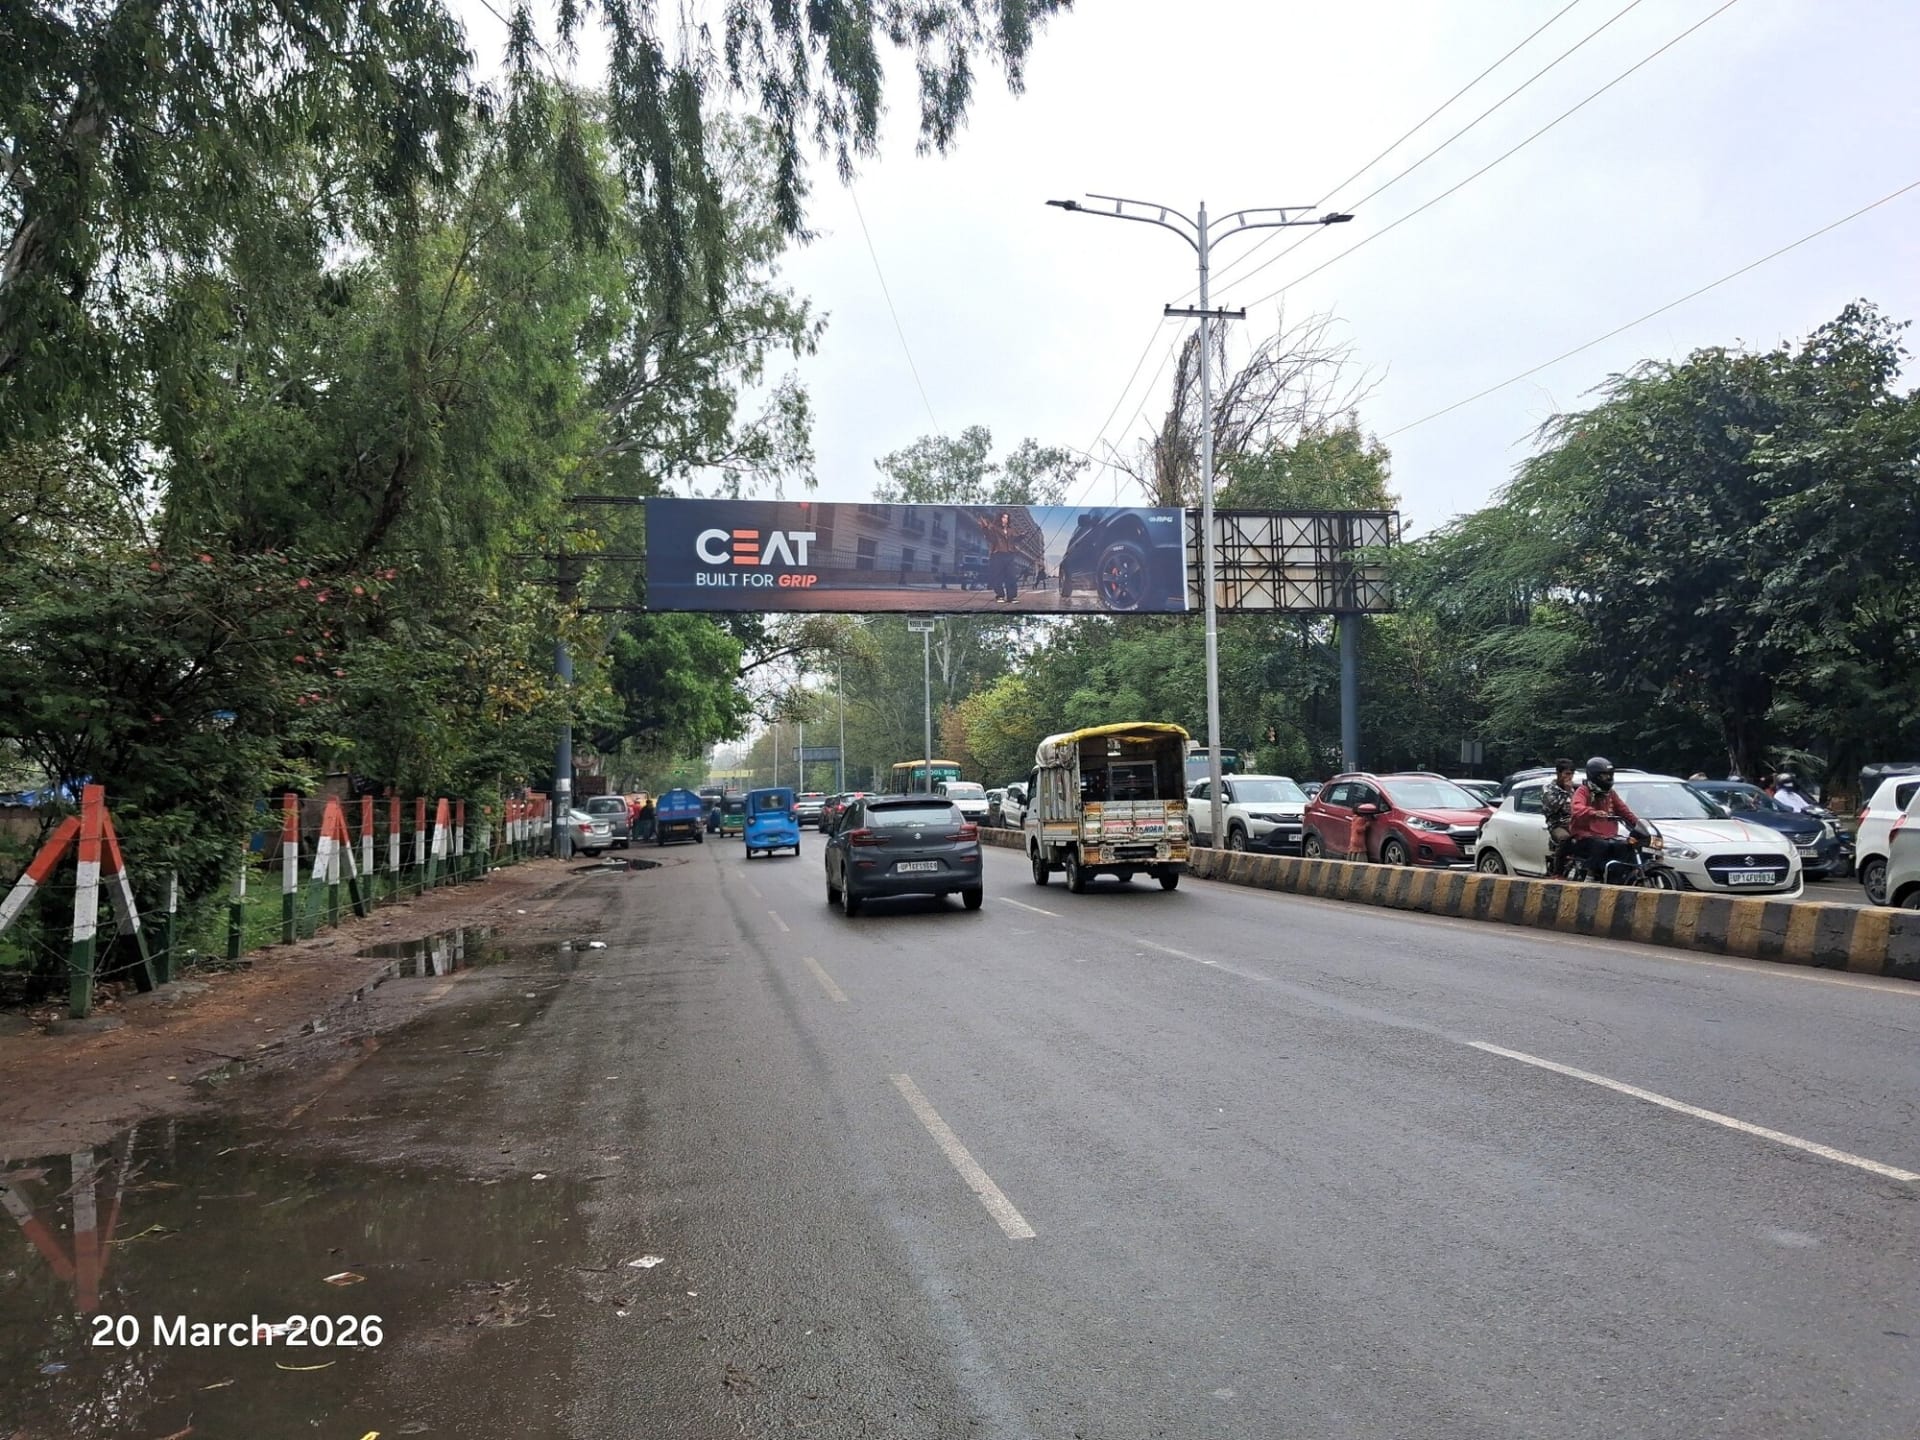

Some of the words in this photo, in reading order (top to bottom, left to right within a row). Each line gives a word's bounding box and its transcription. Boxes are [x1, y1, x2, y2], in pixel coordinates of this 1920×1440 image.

[696, 528, 817, 566] CEAT
[696, 572, 738, 587] BUILT
[743, 573, 774, 587] FOR
[778, 574, 817, 588] GRIP
[915, 769, 943, 777] SCOOL
